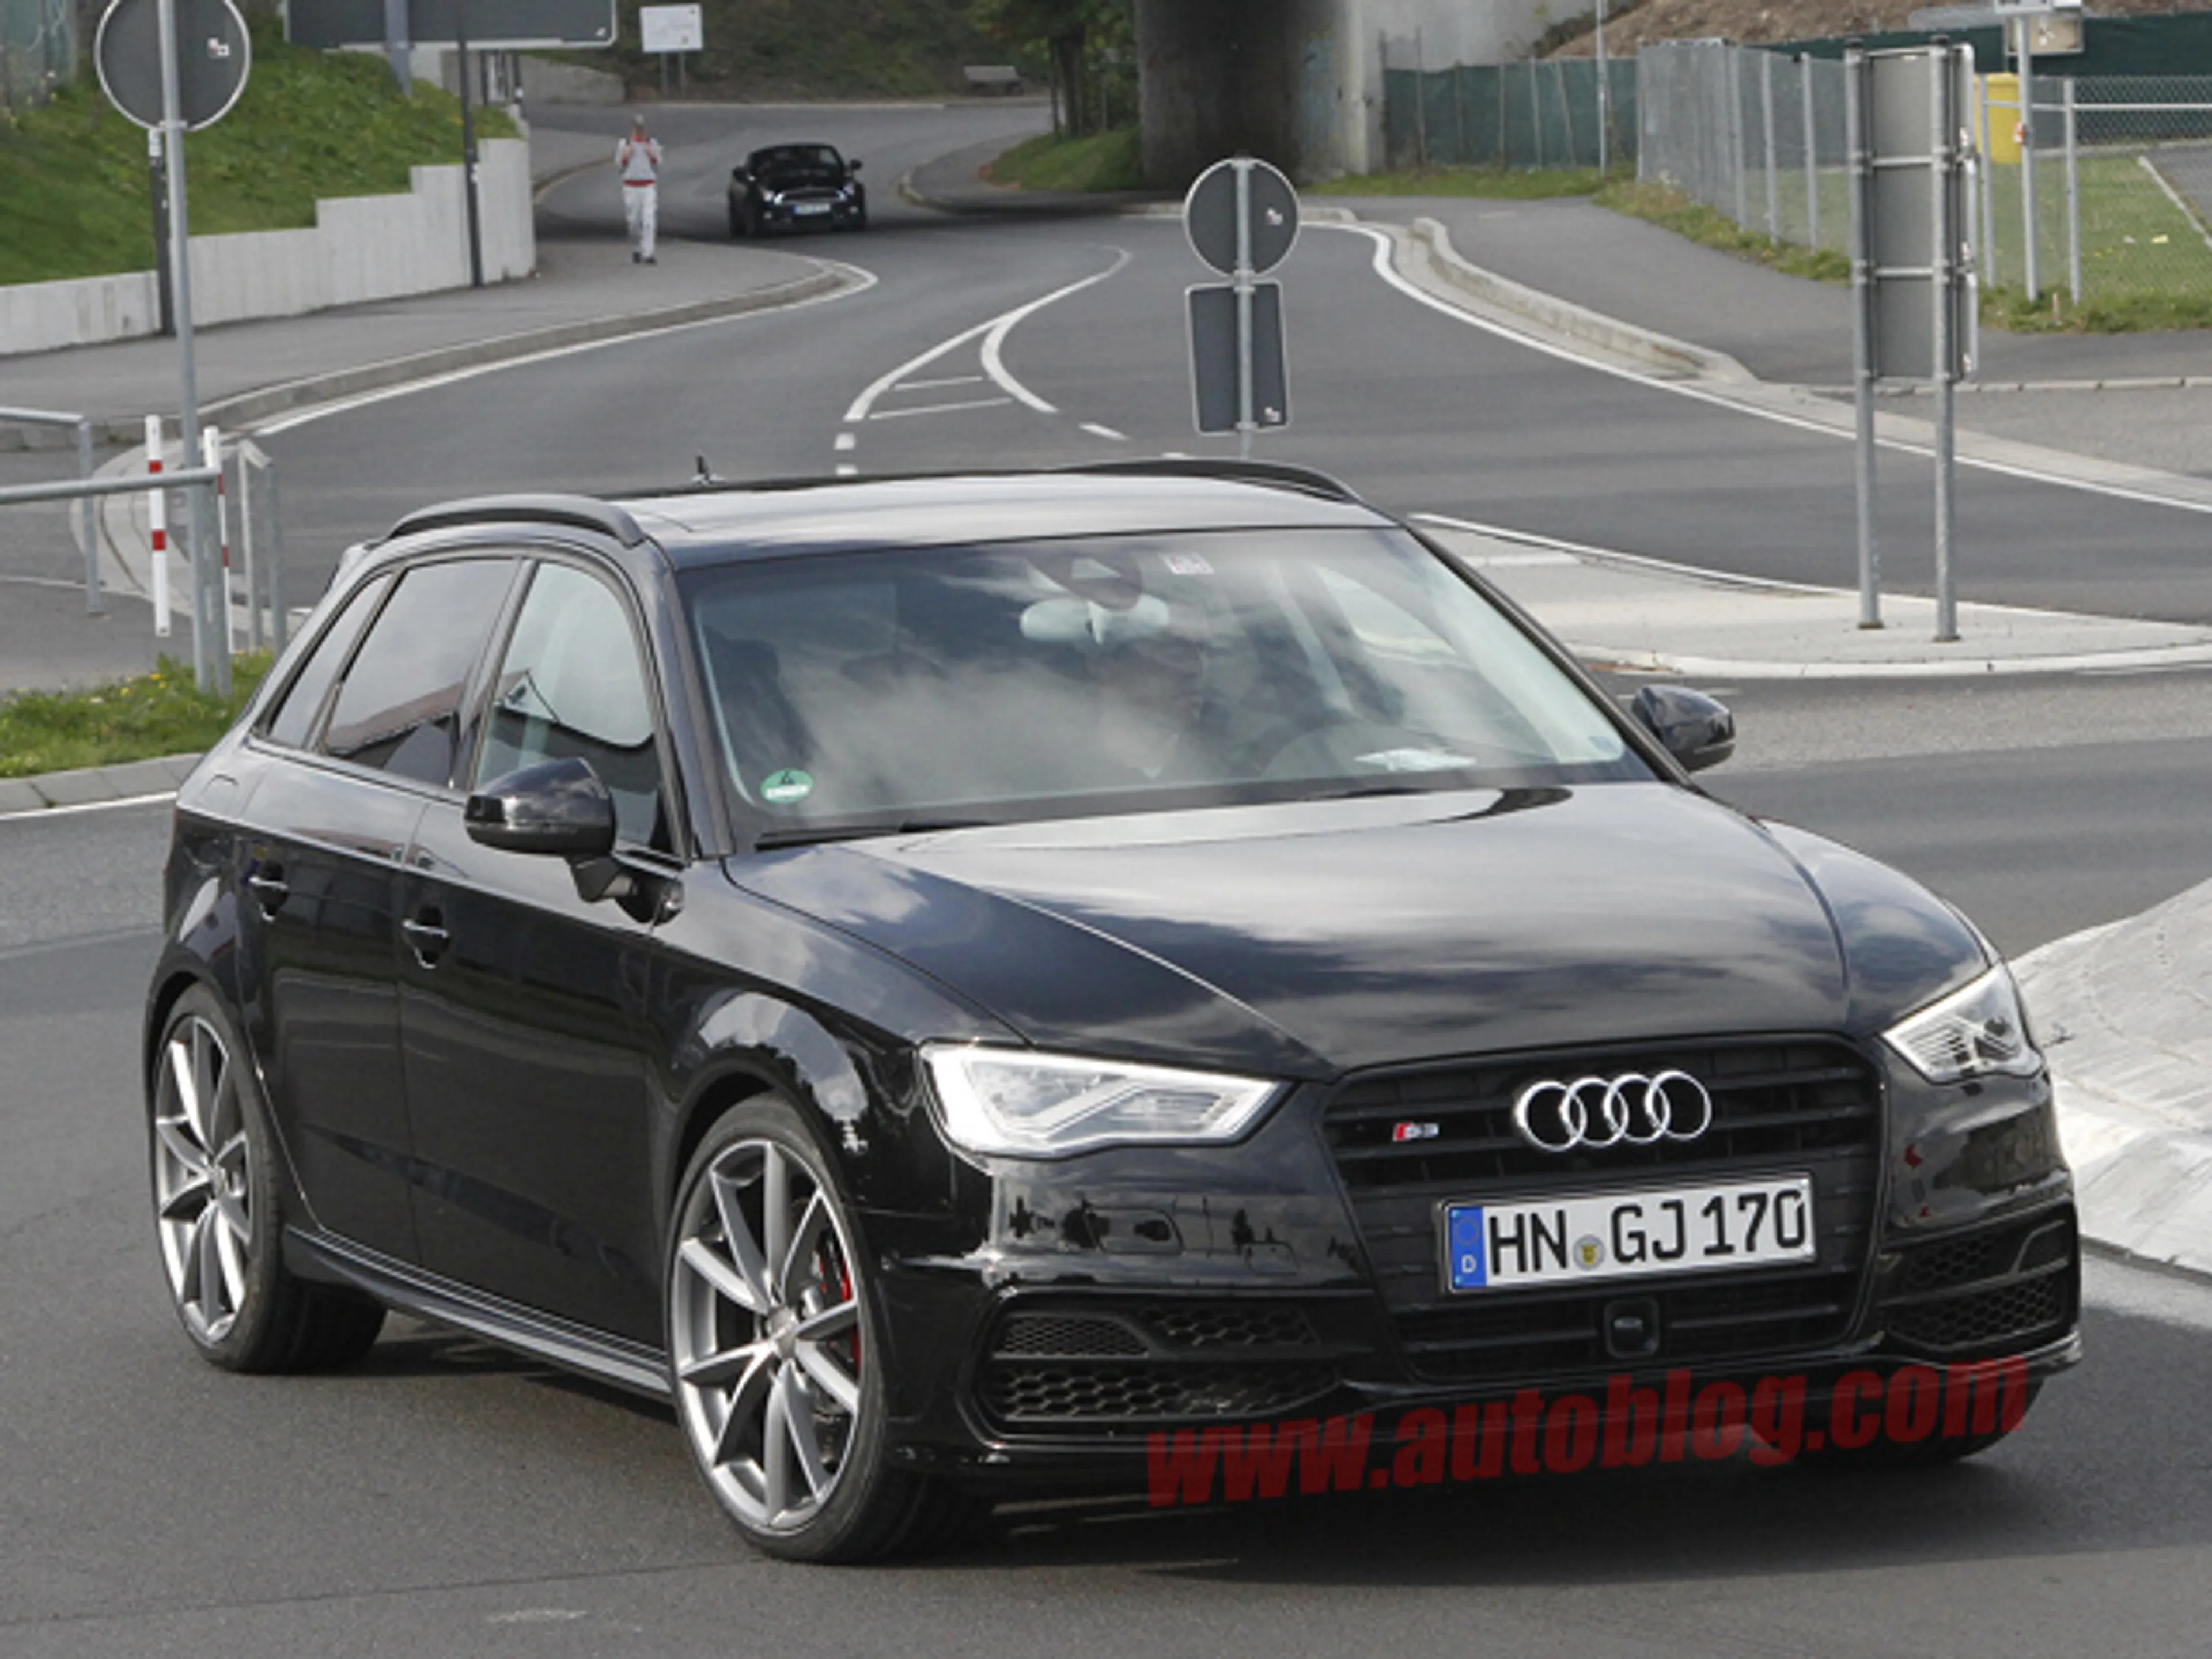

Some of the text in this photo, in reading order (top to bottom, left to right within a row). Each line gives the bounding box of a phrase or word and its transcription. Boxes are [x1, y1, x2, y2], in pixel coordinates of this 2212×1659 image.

[1490, 1189, 1806, 1275] HN GJ 170
[1461, 1255, 1476, 1273] D
